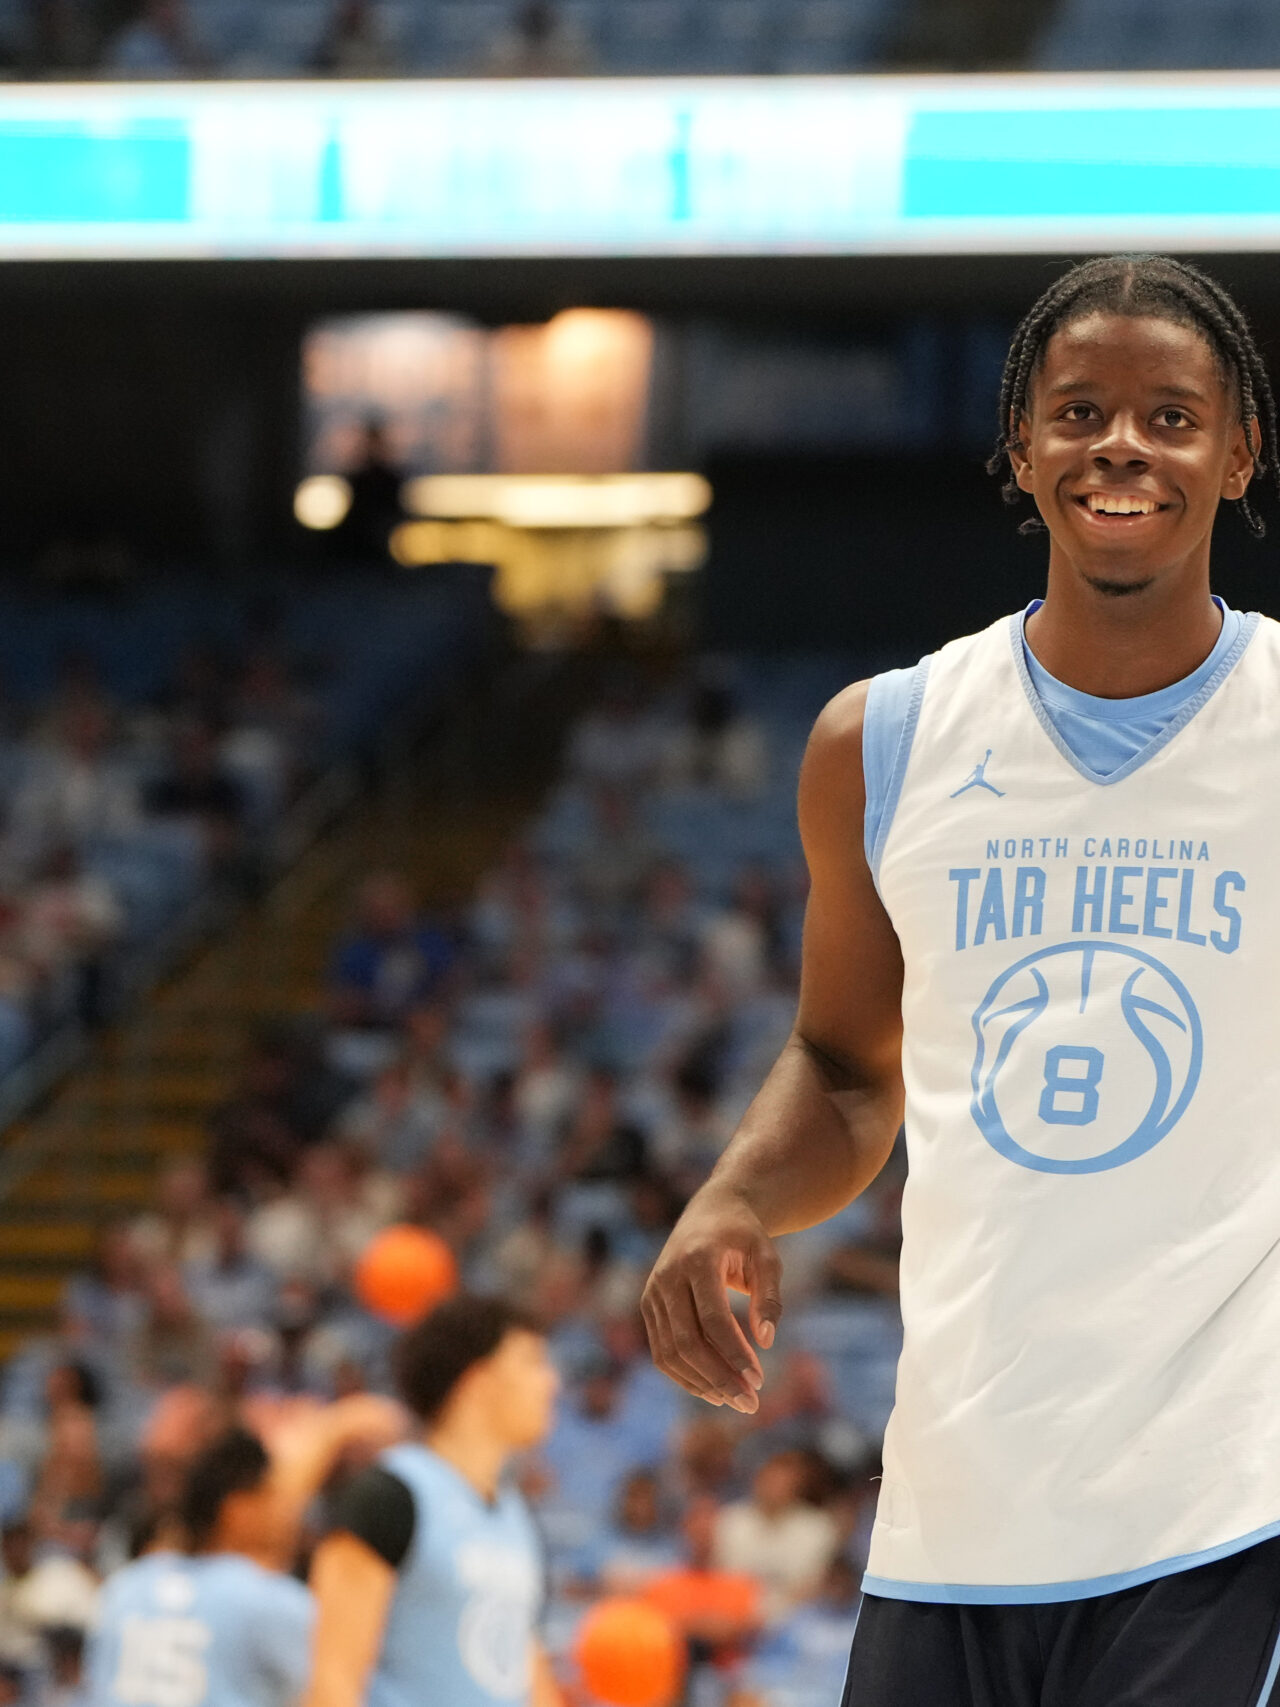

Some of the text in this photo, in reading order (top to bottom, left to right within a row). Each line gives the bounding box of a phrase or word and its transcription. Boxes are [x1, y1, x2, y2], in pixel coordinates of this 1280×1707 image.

[986, 837, 1210, 861] NORTH CAROLINA
[948, 865, 1247, 955] TAR HEELS
[1038, 1044, 1105, 1127] 8
